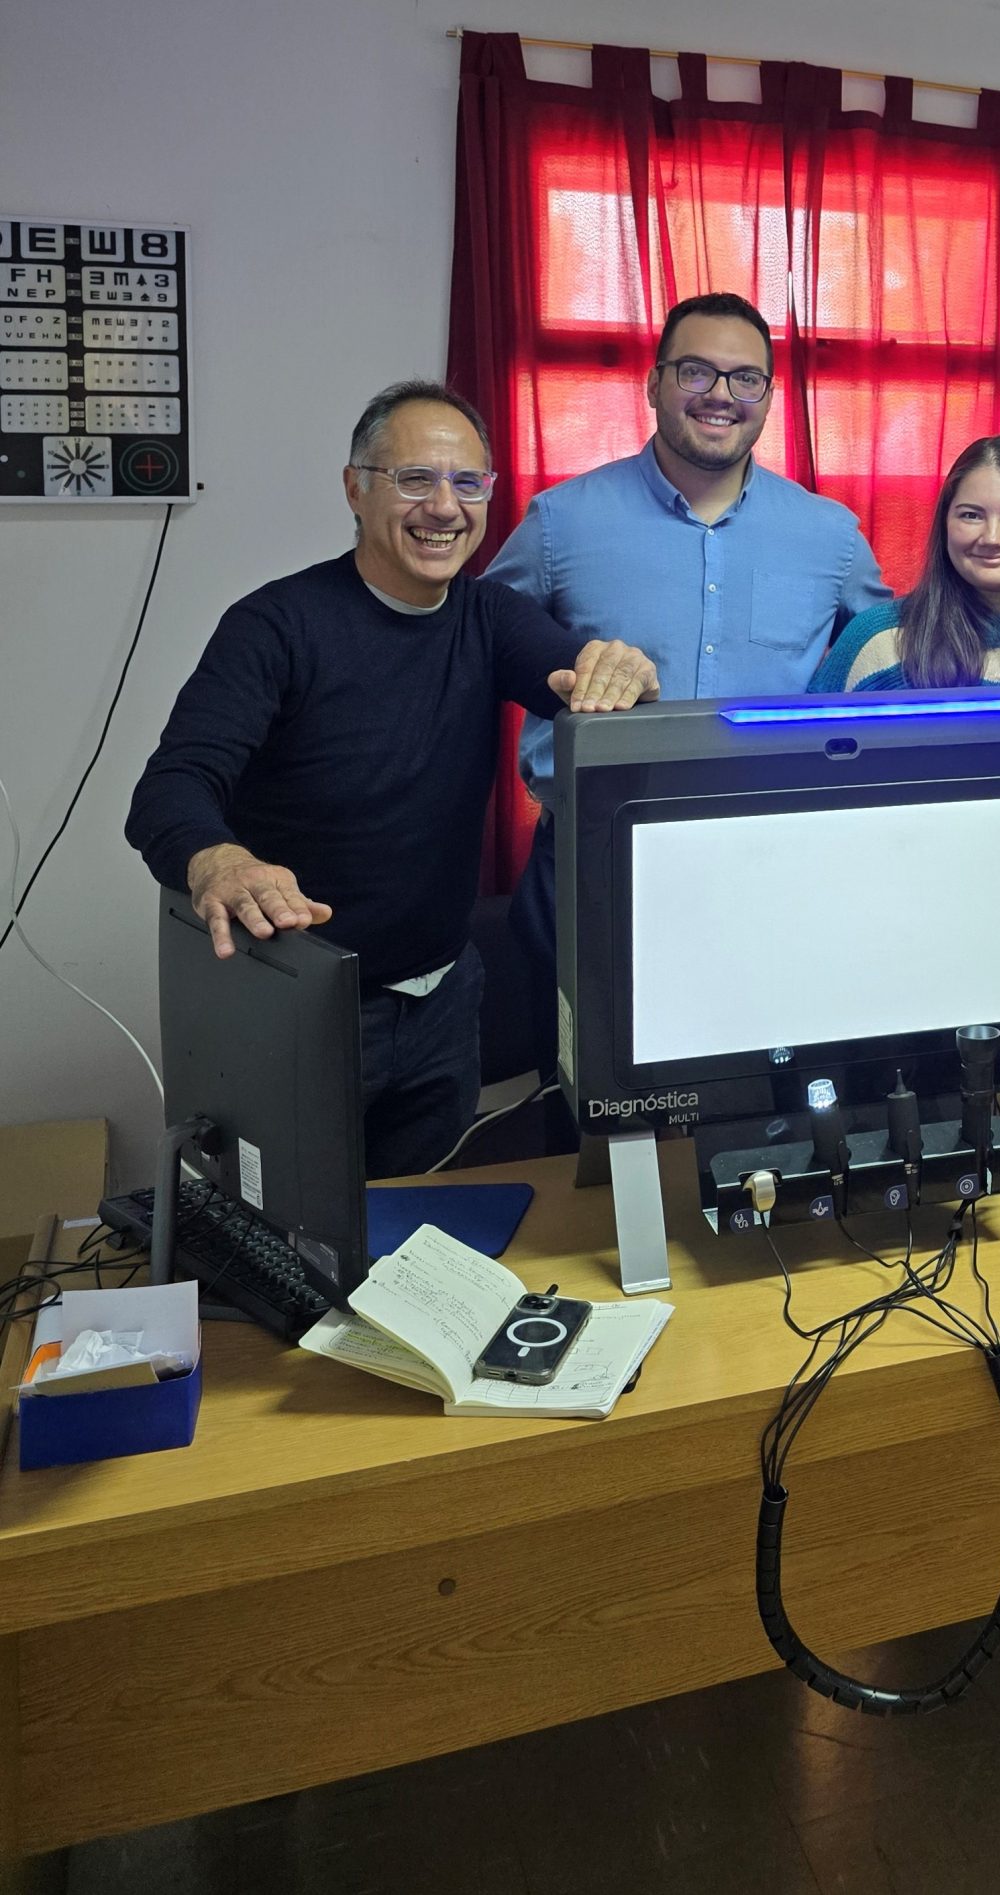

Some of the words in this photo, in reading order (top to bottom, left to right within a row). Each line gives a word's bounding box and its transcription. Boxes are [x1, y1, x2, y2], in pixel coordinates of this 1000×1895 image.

[141, 233, 168, 257] 8
[588, 1091, 699, 1118] Diagnóstica
[668, 1112, 700, 1125] MULTI
